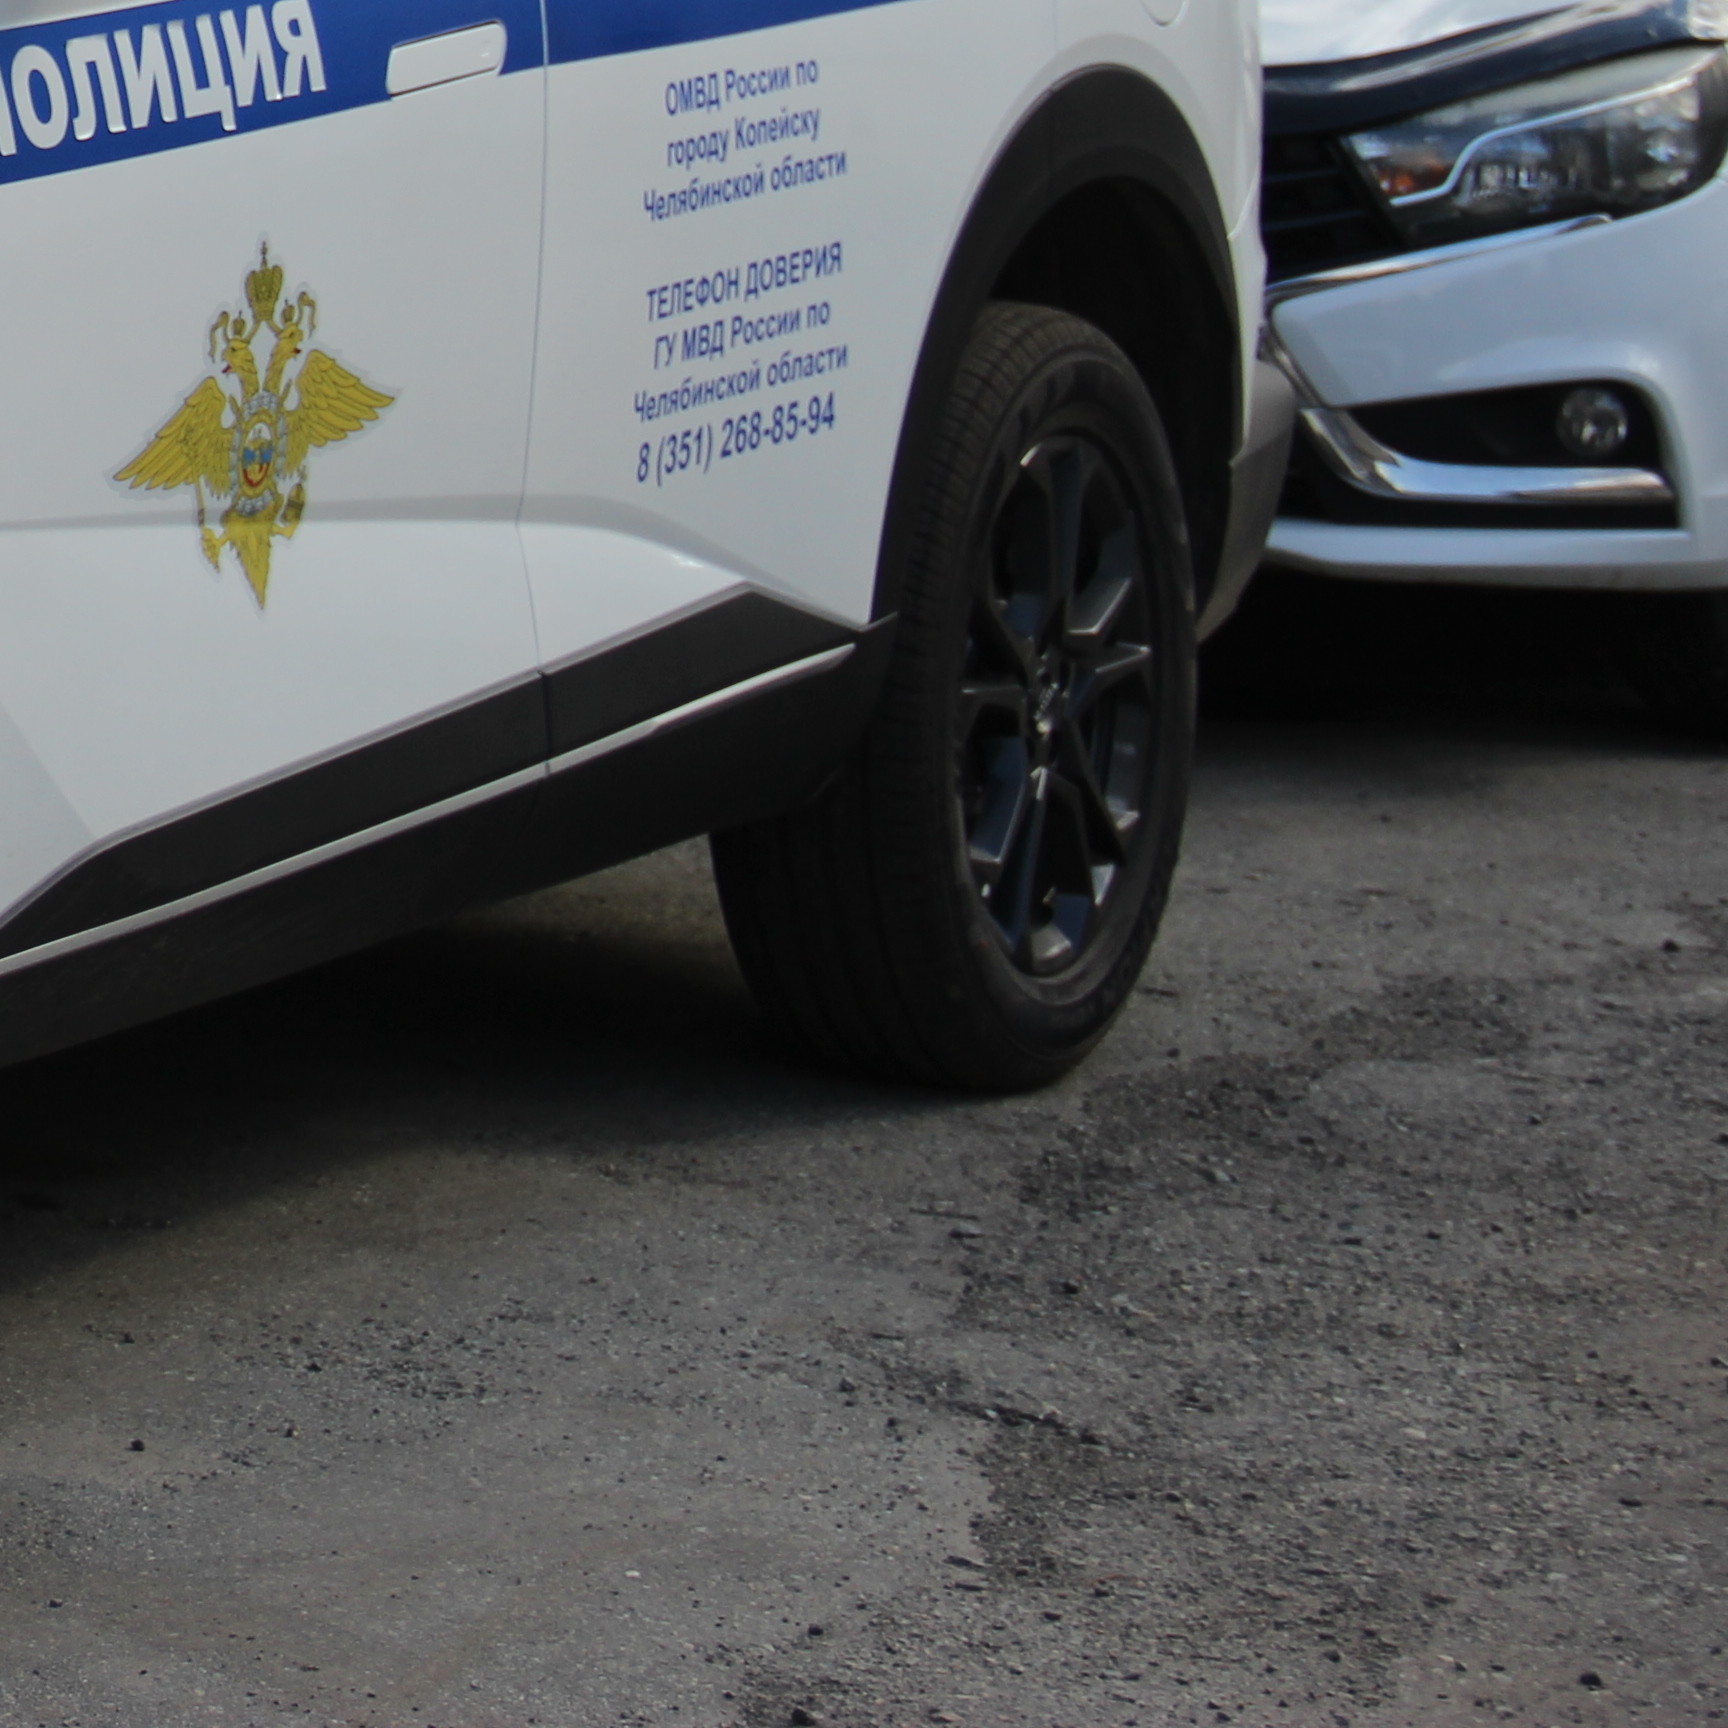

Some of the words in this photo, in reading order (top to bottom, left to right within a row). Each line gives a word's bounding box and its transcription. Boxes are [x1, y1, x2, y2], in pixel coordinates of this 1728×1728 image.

[665, 73, 720, 116] ОМВД
[725, 68, 791, 101] России
[796, 60, 819, 86] по
[667, 128, 730, 171] городу
[735, 107, 821, 151] Копейску
[644, 164, 765, 223] Челябинской
[770, 151, 847, 190] области
[646, 267, 740, 322] ТЕЛЕФОН
[744, 241, 843, 303] ДОВЕРИЯ
[654, 333, 676, 370] ГУ
[681, 320, 725, 362] МВД
[730, 306, 800, 349] России
[806, 300, 831, 328] по
[634, 360, 761, 423] Челябинской
[766, 343, 849, 387] области
[637, 441, 651, 484] 8
[656, 424, 714, 488] (351)
[719, 392, 836, 459] 268-85-94
